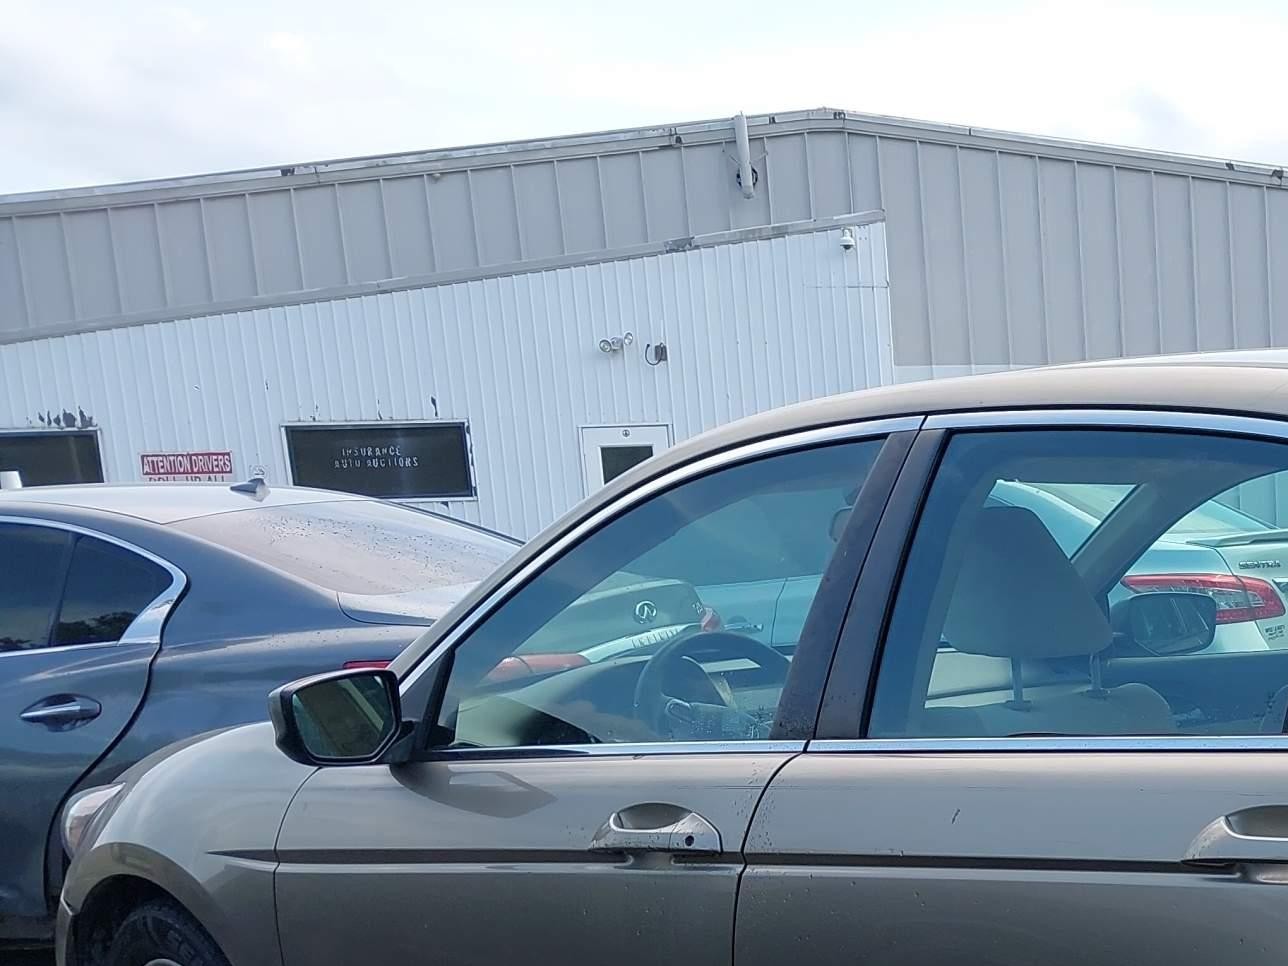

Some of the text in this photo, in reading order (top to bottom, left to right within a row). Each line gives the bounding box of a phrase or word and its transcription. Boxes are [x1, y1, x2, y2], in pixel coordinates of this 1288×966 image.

[342, 446, 401, 456] INSURANCE
[143, 456, 191, 474] ATTENTION
[192, 455, 231, 472] DRIVERS
